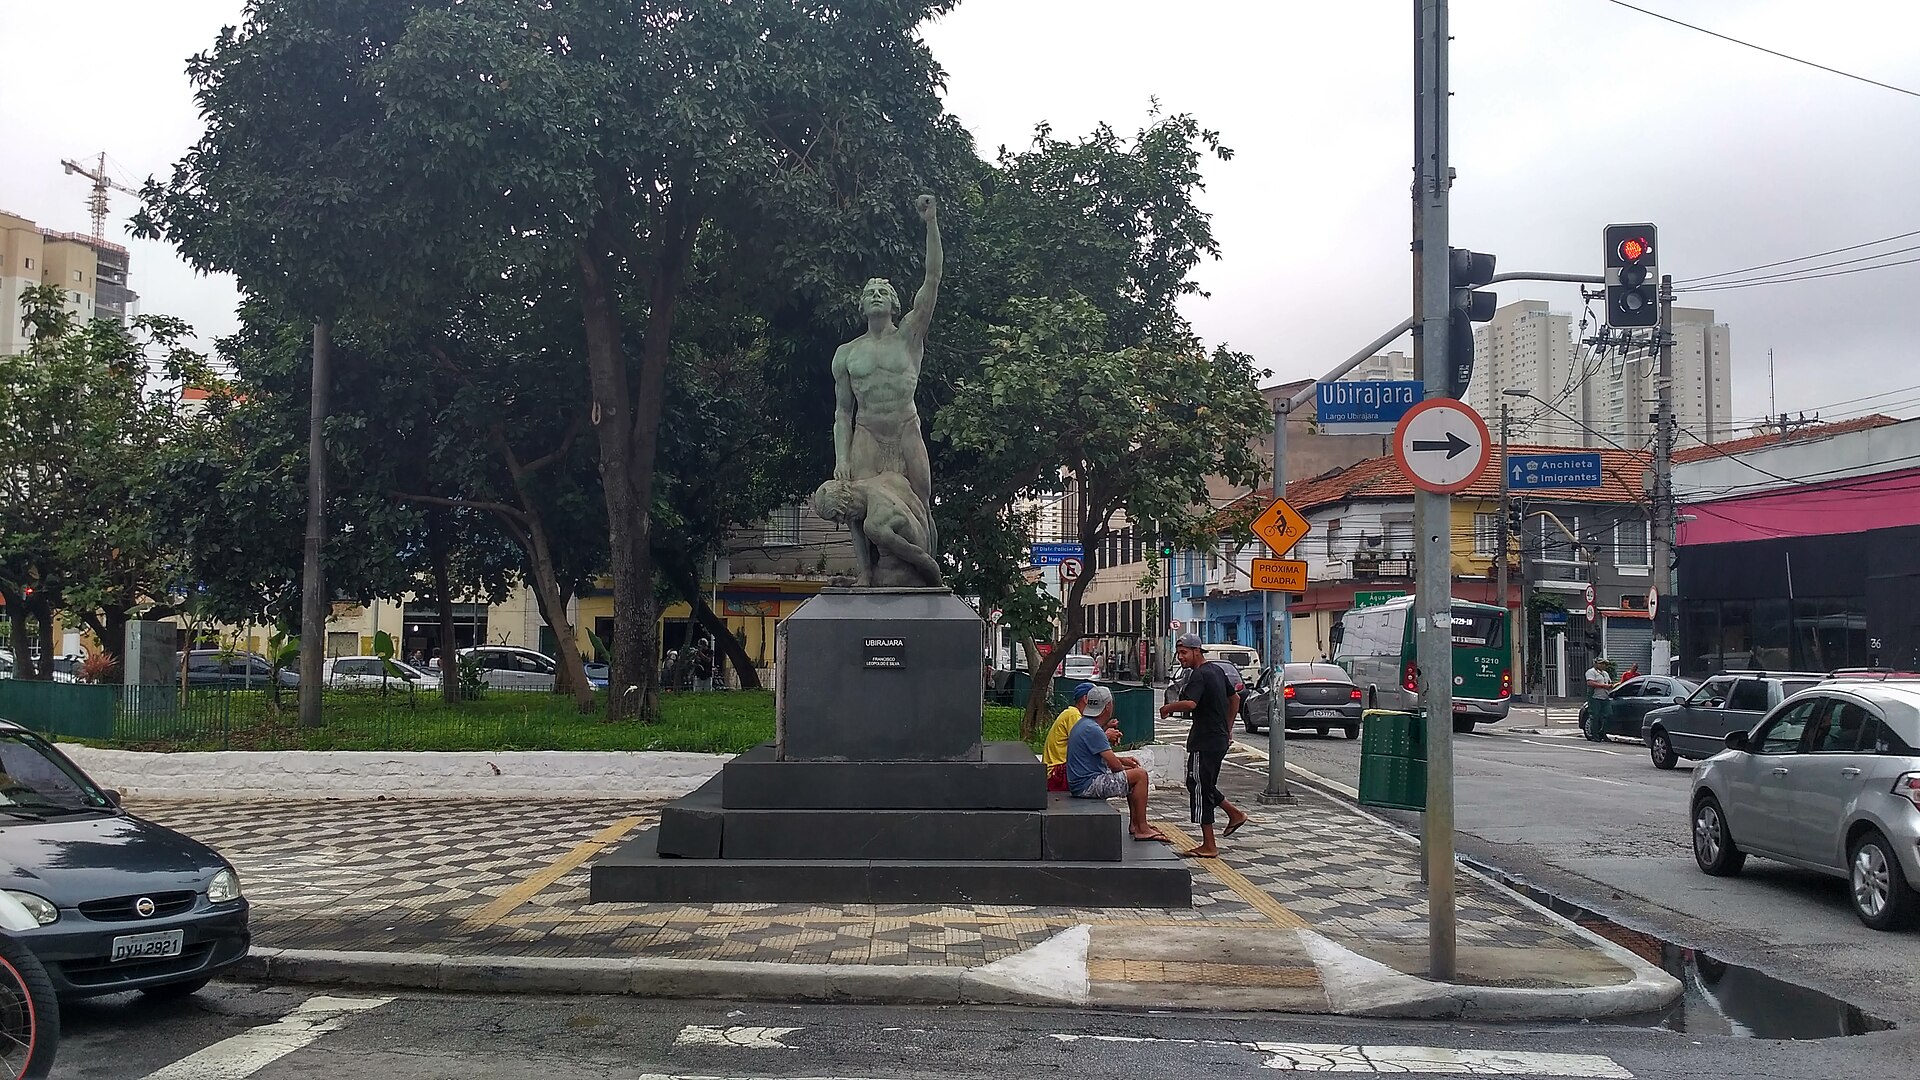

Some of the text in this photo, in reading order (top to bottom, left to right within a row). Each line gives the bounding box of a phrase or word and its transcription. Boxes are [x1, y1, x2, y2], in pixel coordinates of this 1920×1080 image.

[1323, 383, 1412, 409] Ubirajara
[1325, 412, 1379, 420] Largo Ubirajara
[1541, 460, 1593, 469] Anchieta
[1541, 473, 1597, 483] Imigrantes
[1259, 563, 1299, 574] PRÓXIMA
[1260, 576, 1297, 585] QUADRA
[865, 639, 904, 647] UBIRAJARA
[1870, 638, 1881, 649] 36
[1481, 657, 1499, 665] 5210
